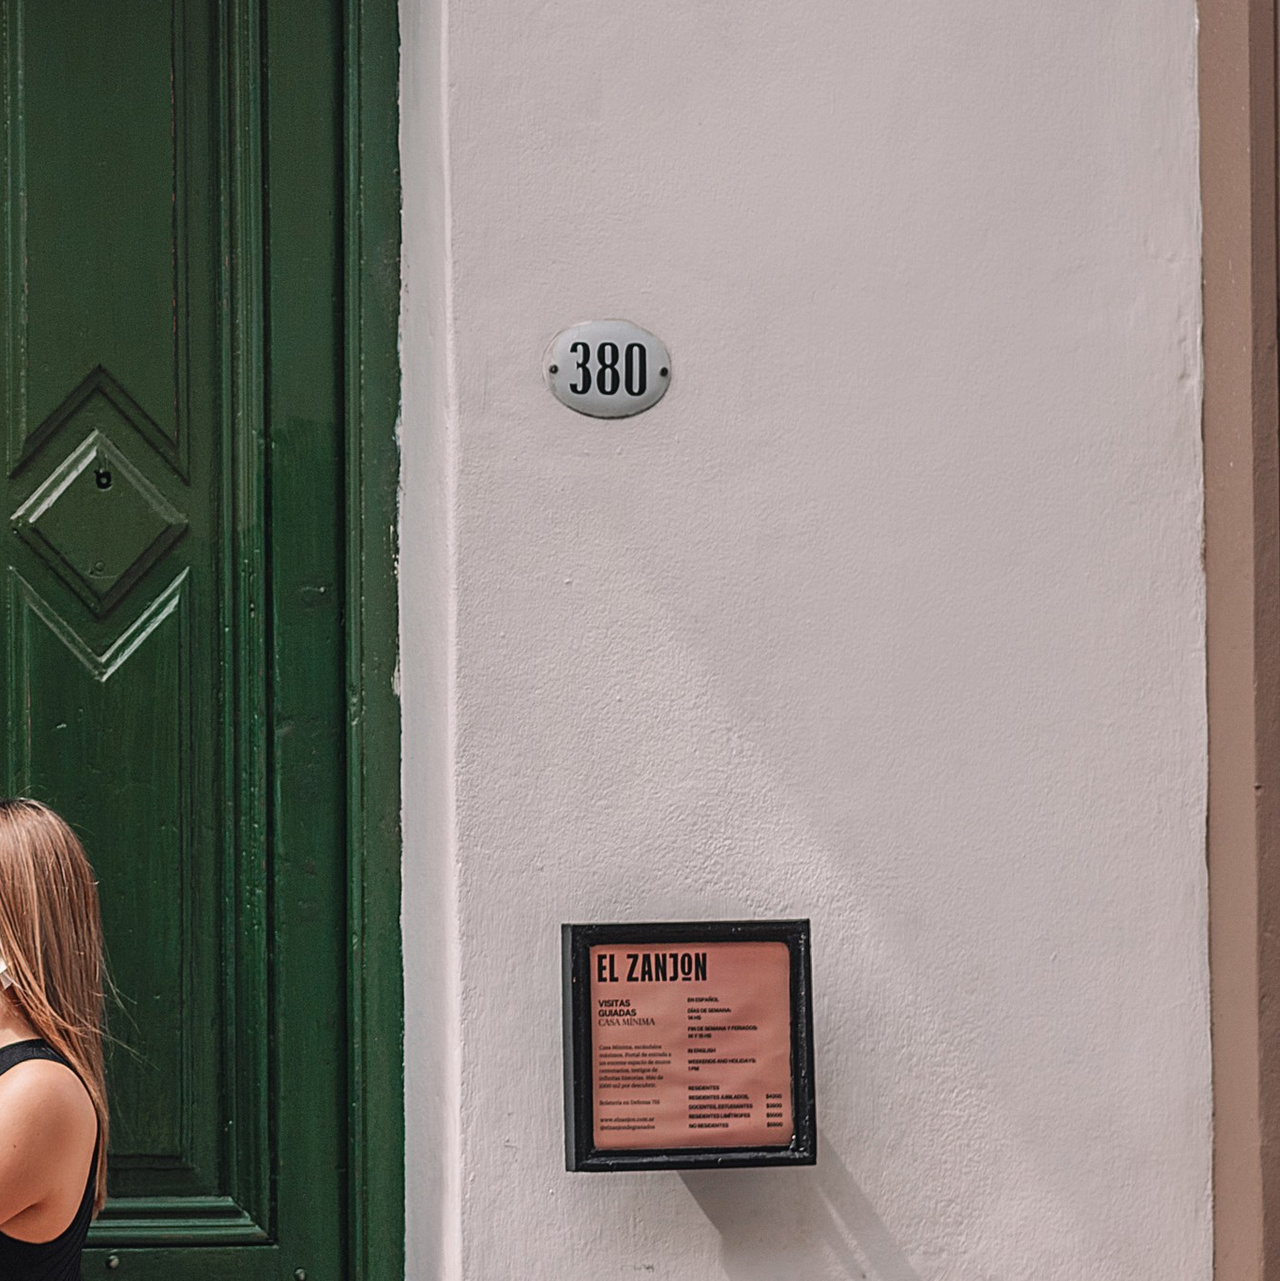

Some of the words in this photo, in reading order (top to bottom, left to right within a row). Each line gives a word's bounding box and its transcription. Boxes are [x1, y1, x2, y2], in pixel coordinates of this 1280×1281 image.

[570, 342, 646, 396] 380
[598, 953, 618, 982] EL
[627, 953, 706, 982] ZANJON
[599, 999, 630, 1007] VISITAS
[599, 1009, 636, 1017] GUIADAS
[623, 1017, 655, 1026] MÍNIMA
